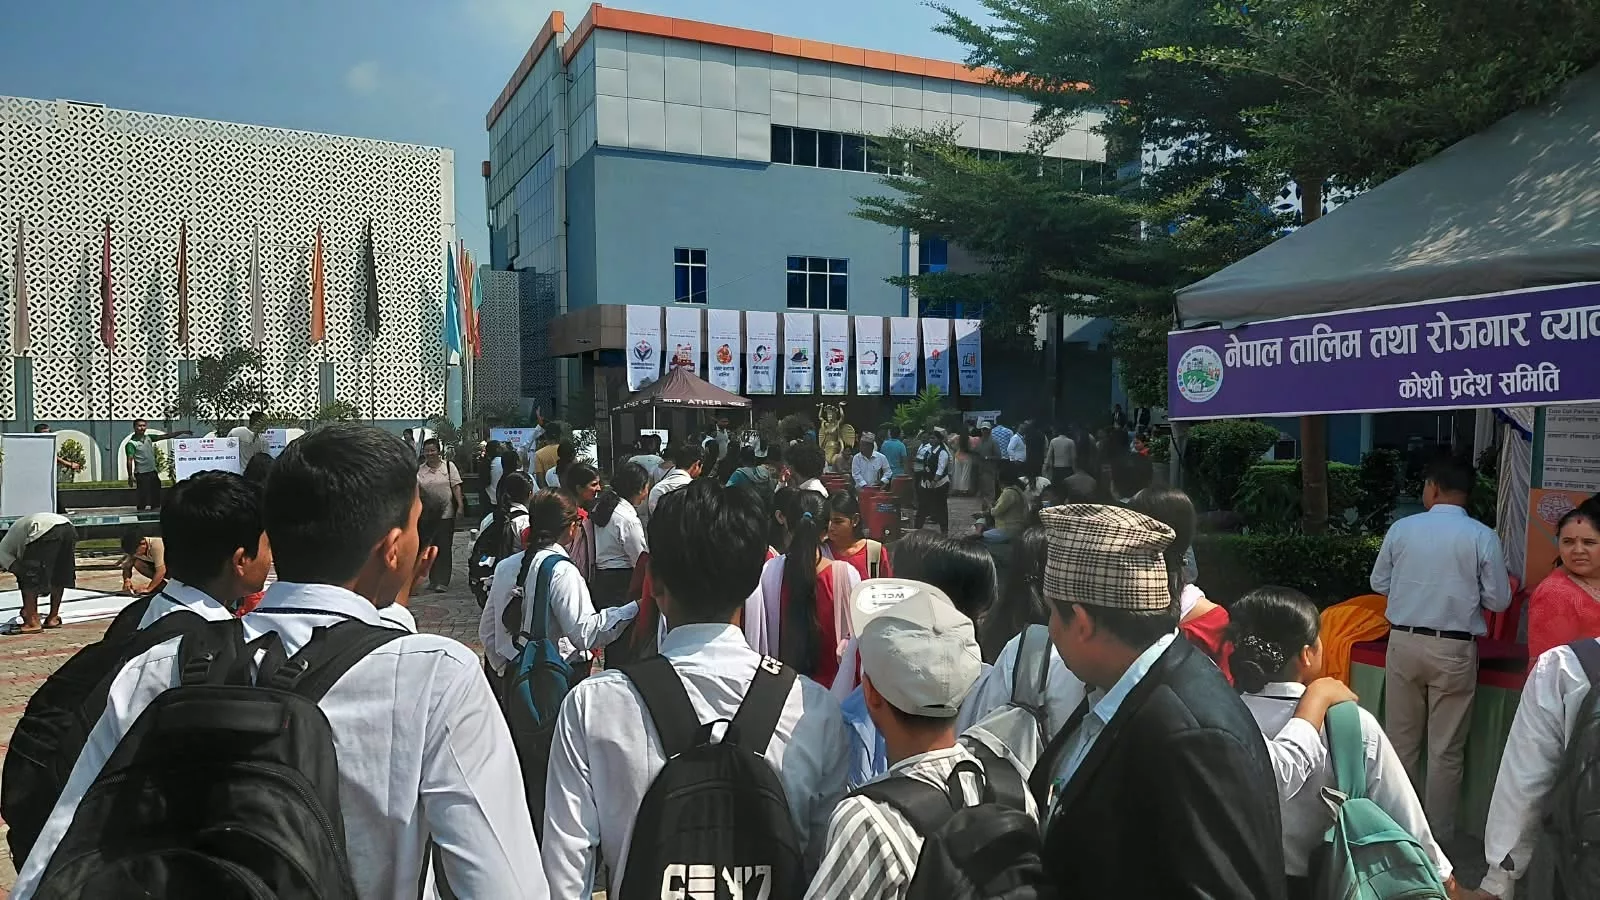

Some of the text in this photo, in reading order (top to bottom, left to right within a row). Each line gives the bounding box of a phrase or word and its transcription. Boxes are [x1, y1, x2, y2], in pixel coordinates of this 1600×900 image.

[1224, 333, 1283, 368] नेपाल
[1289, 323, 1363, 365] तालिम
[1369, 324, 1419, 357] तथा
[1426, 311, 1532, 354] रोजगार
[1398, 361, 1561, 400] कोशी प्रदेश समिति
[687, 398, 722, 406] ATHER
